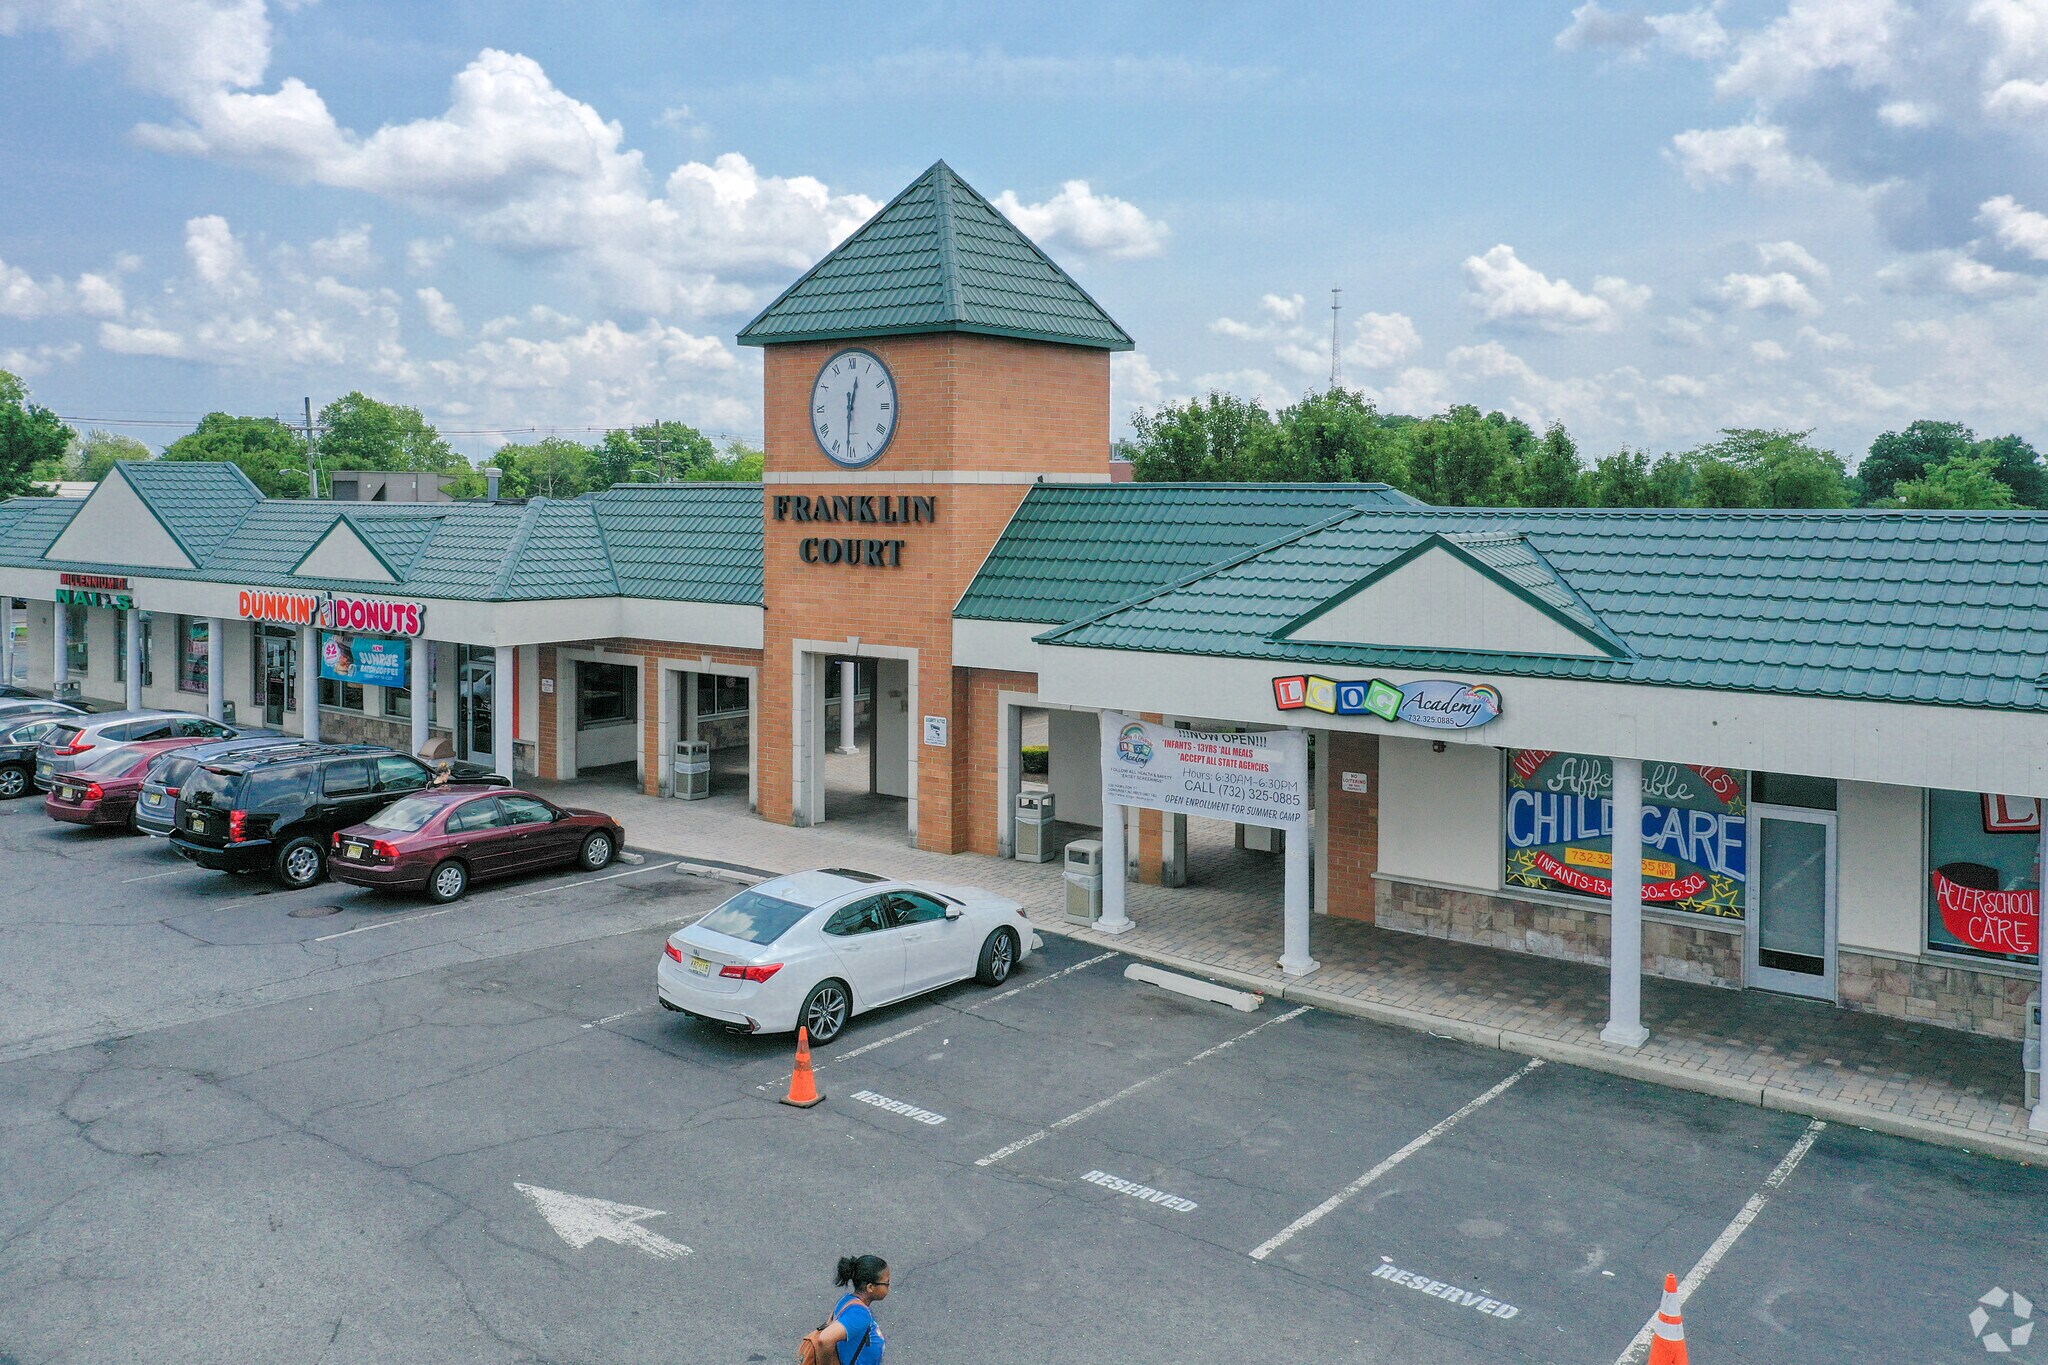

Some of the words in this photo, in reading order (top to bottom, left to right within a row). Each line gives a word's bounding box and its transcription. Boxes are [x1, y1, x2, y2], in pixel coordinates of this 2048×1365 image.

[772, 495, 936, 523] FRANKLIN
[799, 538, 905, 567] COURT
[61, 573, 114, 590] MILLENNIUM
[56, 589, 130, 611] NAIS
[239, 591, 315, 625] DUNKIN'
[337, 599, 419, 635] DONUTS
[1402, 686, 1482, 728] Academy
[1408, 714, 1455, 725] 732.325.0885
[1197, 743, 1218, 754] 13YRS
[1232, 748, 1253, 759] MEALS
[1221, 733, 1267, 748] OPEN!!!
[1182, 767, 1213, 780] Hours:
[1206, 757, 1217, 766] ALL
[1217, 758, 1238, 769] STATE
[1238, 760, 1269, 773] AGENCIES
[1184, 780, 1215, 794] CALL
[1218, 784, 1246, 800] (732)
[1248, 788, 1301, 806] 325-0885
[1164, 794, 1184, 805] OPEN
[1185, 797, 1230, 812] ENROLLMENT
[1231, 804, 1245, 815] FOR
[1246, 806, 1278, 819] SUMMER
[1279, 811, 1301, 822] CAMP
[1969, 917, 2032, 952] CARE
[849, 1090, 948, 1125] RESERVED
[1081, 1170, 1198, 1212] RESERVED
[1371, 1263, 1520, 1319] RESERVED
